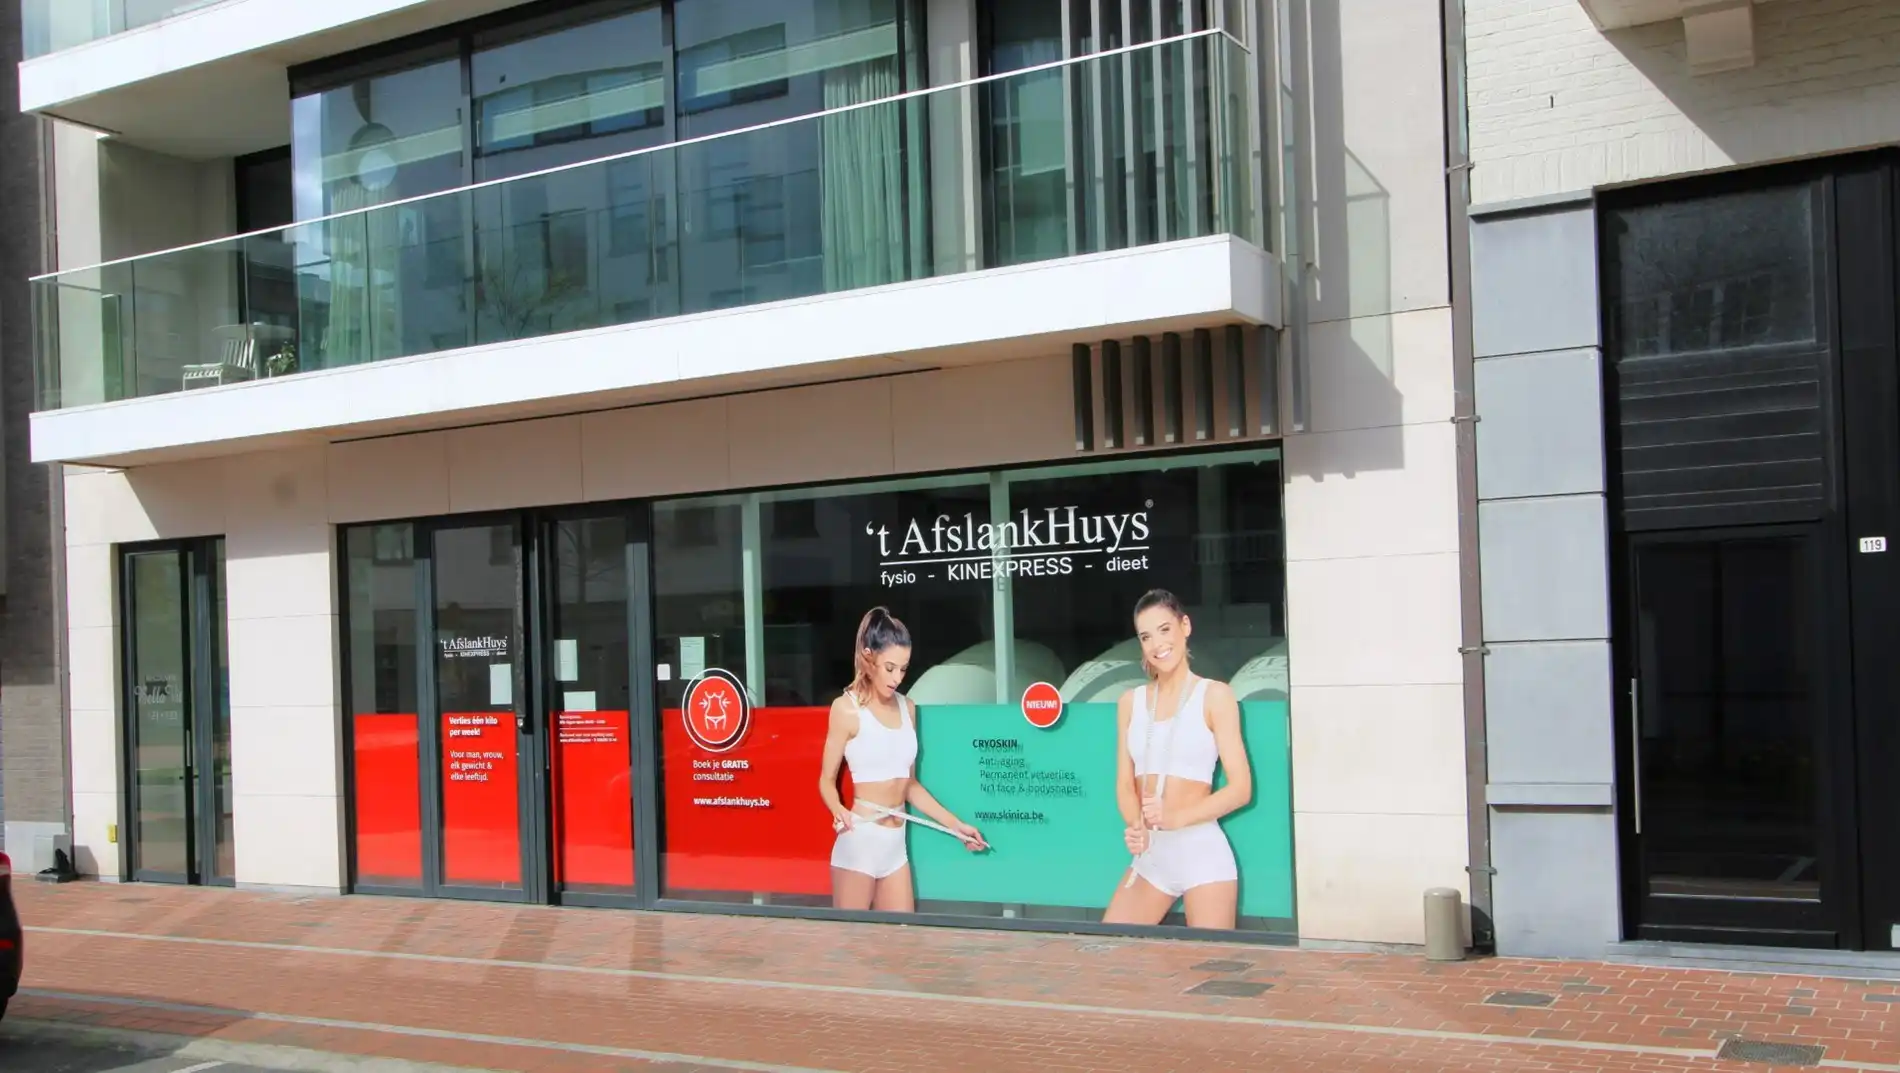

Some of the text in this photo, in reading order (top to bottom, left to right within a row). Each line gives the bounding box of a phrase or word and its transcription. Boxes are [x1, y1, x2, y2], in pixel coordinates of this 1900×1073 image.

[1864, 539, 1882, 551] 119
[880, 569, 916, 587] fysio
[947, 556, 1073, 581] KINEXPRESS
[1106, 555, 1149, 572] dieet
[1026, 699, 1057, 709] NIEUW!
[485, 716, 498, 725] kilo
[449, 729, 461, 738] per
[972, 739, 1018, 749] CRYOSKIN
[450, 751, 504, 760] Voor man, vrouw,
[450, 761, 493, 771] elk gewicht &
[693, 759, 749, 771] Boek je GRATIS
[979, 756, 1025, 768] Anti-aging
[450, 772, 489, 783] elke leeftijd.
[693, 772, 734, 782] consultatie
[980, 769, 1028, 780] Permanent
[996, 783, 1016, 793] face
[1018, 783, 1026, 794] &
[693, 796, 770, 808] www.afslankhuys.be
[974, 809, 1044, 821] www.skinica.be
